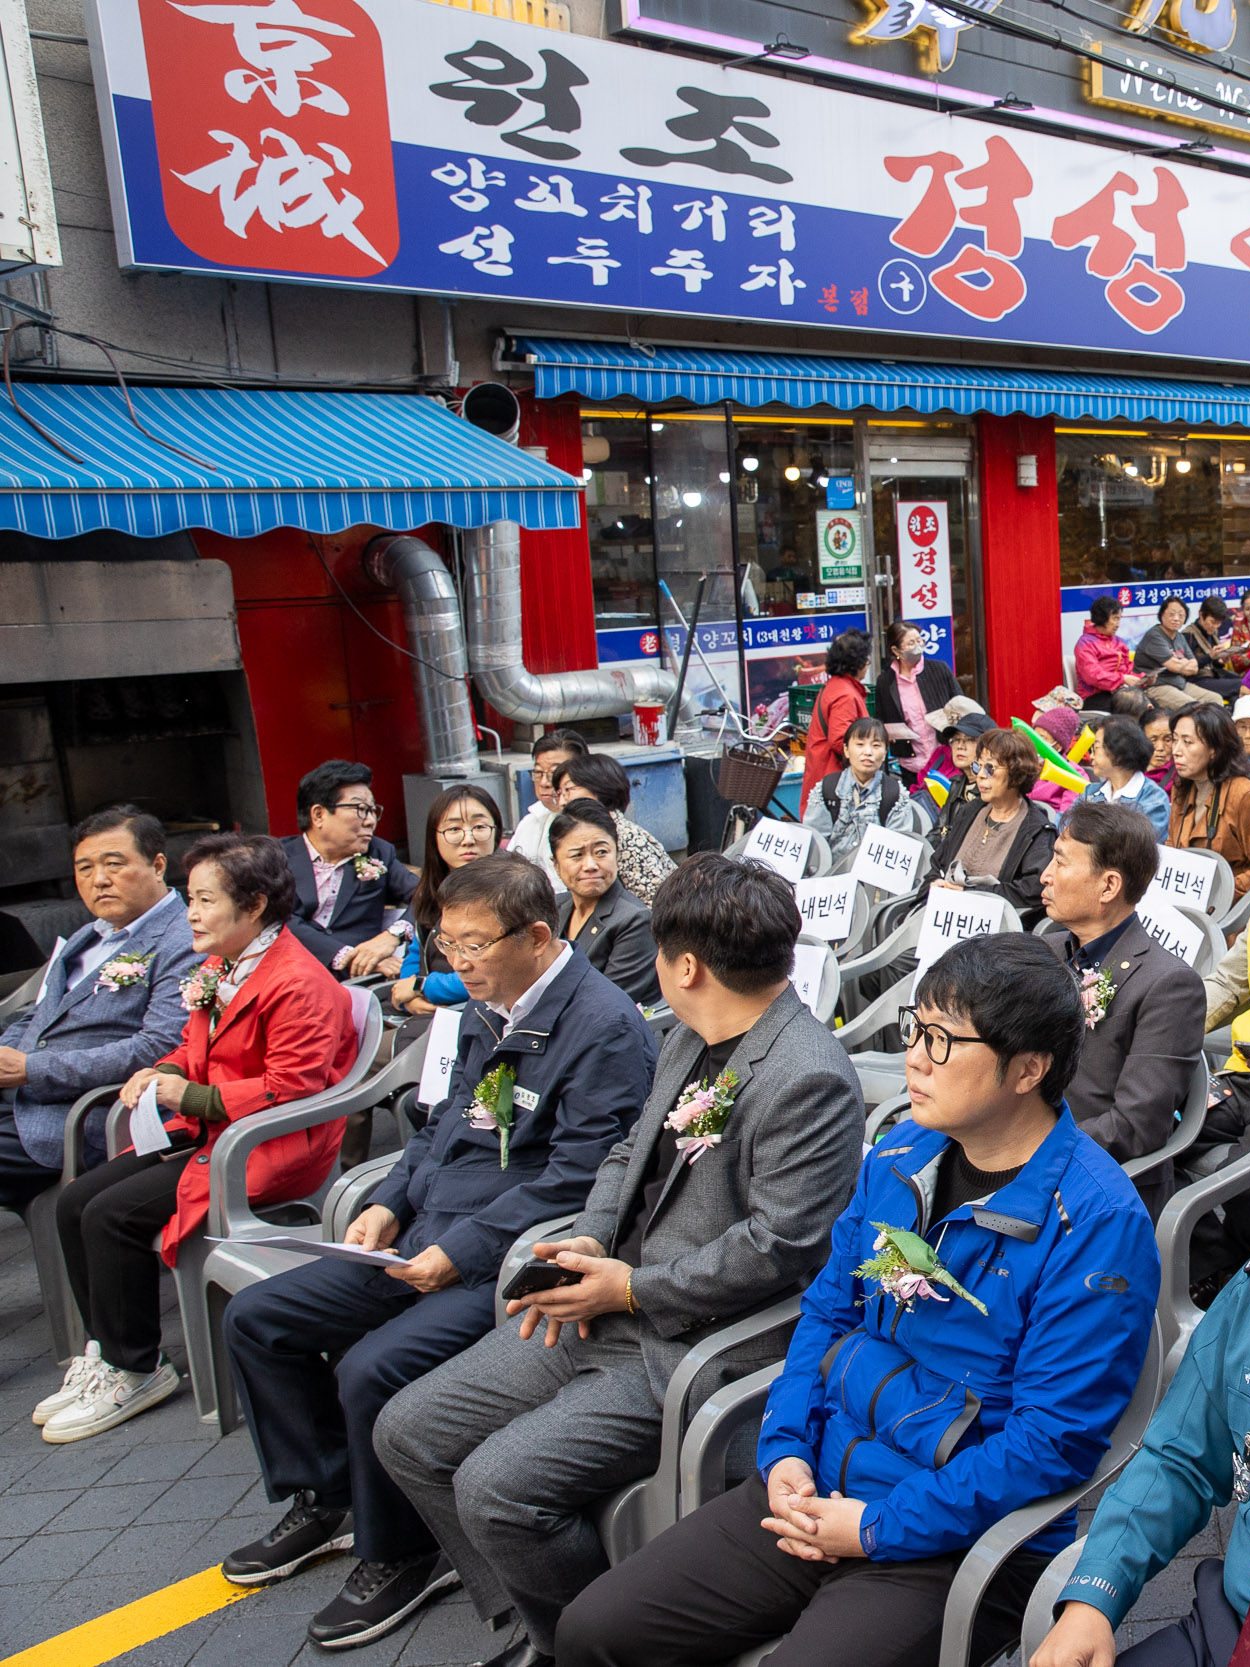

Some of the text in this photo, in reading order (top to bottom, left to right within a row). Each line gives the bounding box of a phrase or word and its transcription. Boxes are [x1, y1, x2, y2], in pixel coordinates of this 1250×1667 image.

[1120, 57, 1203, 112] Nine
[430, 40, 794, 184] 원조
[431, 158, 796, 252] 양꼬치거리
[438, 224, 806, 306] 선두주자
[817, 283, 868, 316] 본점
[909, 514, 937, 536] 원조
[756, 832, 803, 863] 내빈석
[866, 841, 913, 876] 내빈석
[1156, 864, 1208, 902] 내빈석
[800, 889, 849, 920] 내빈석
